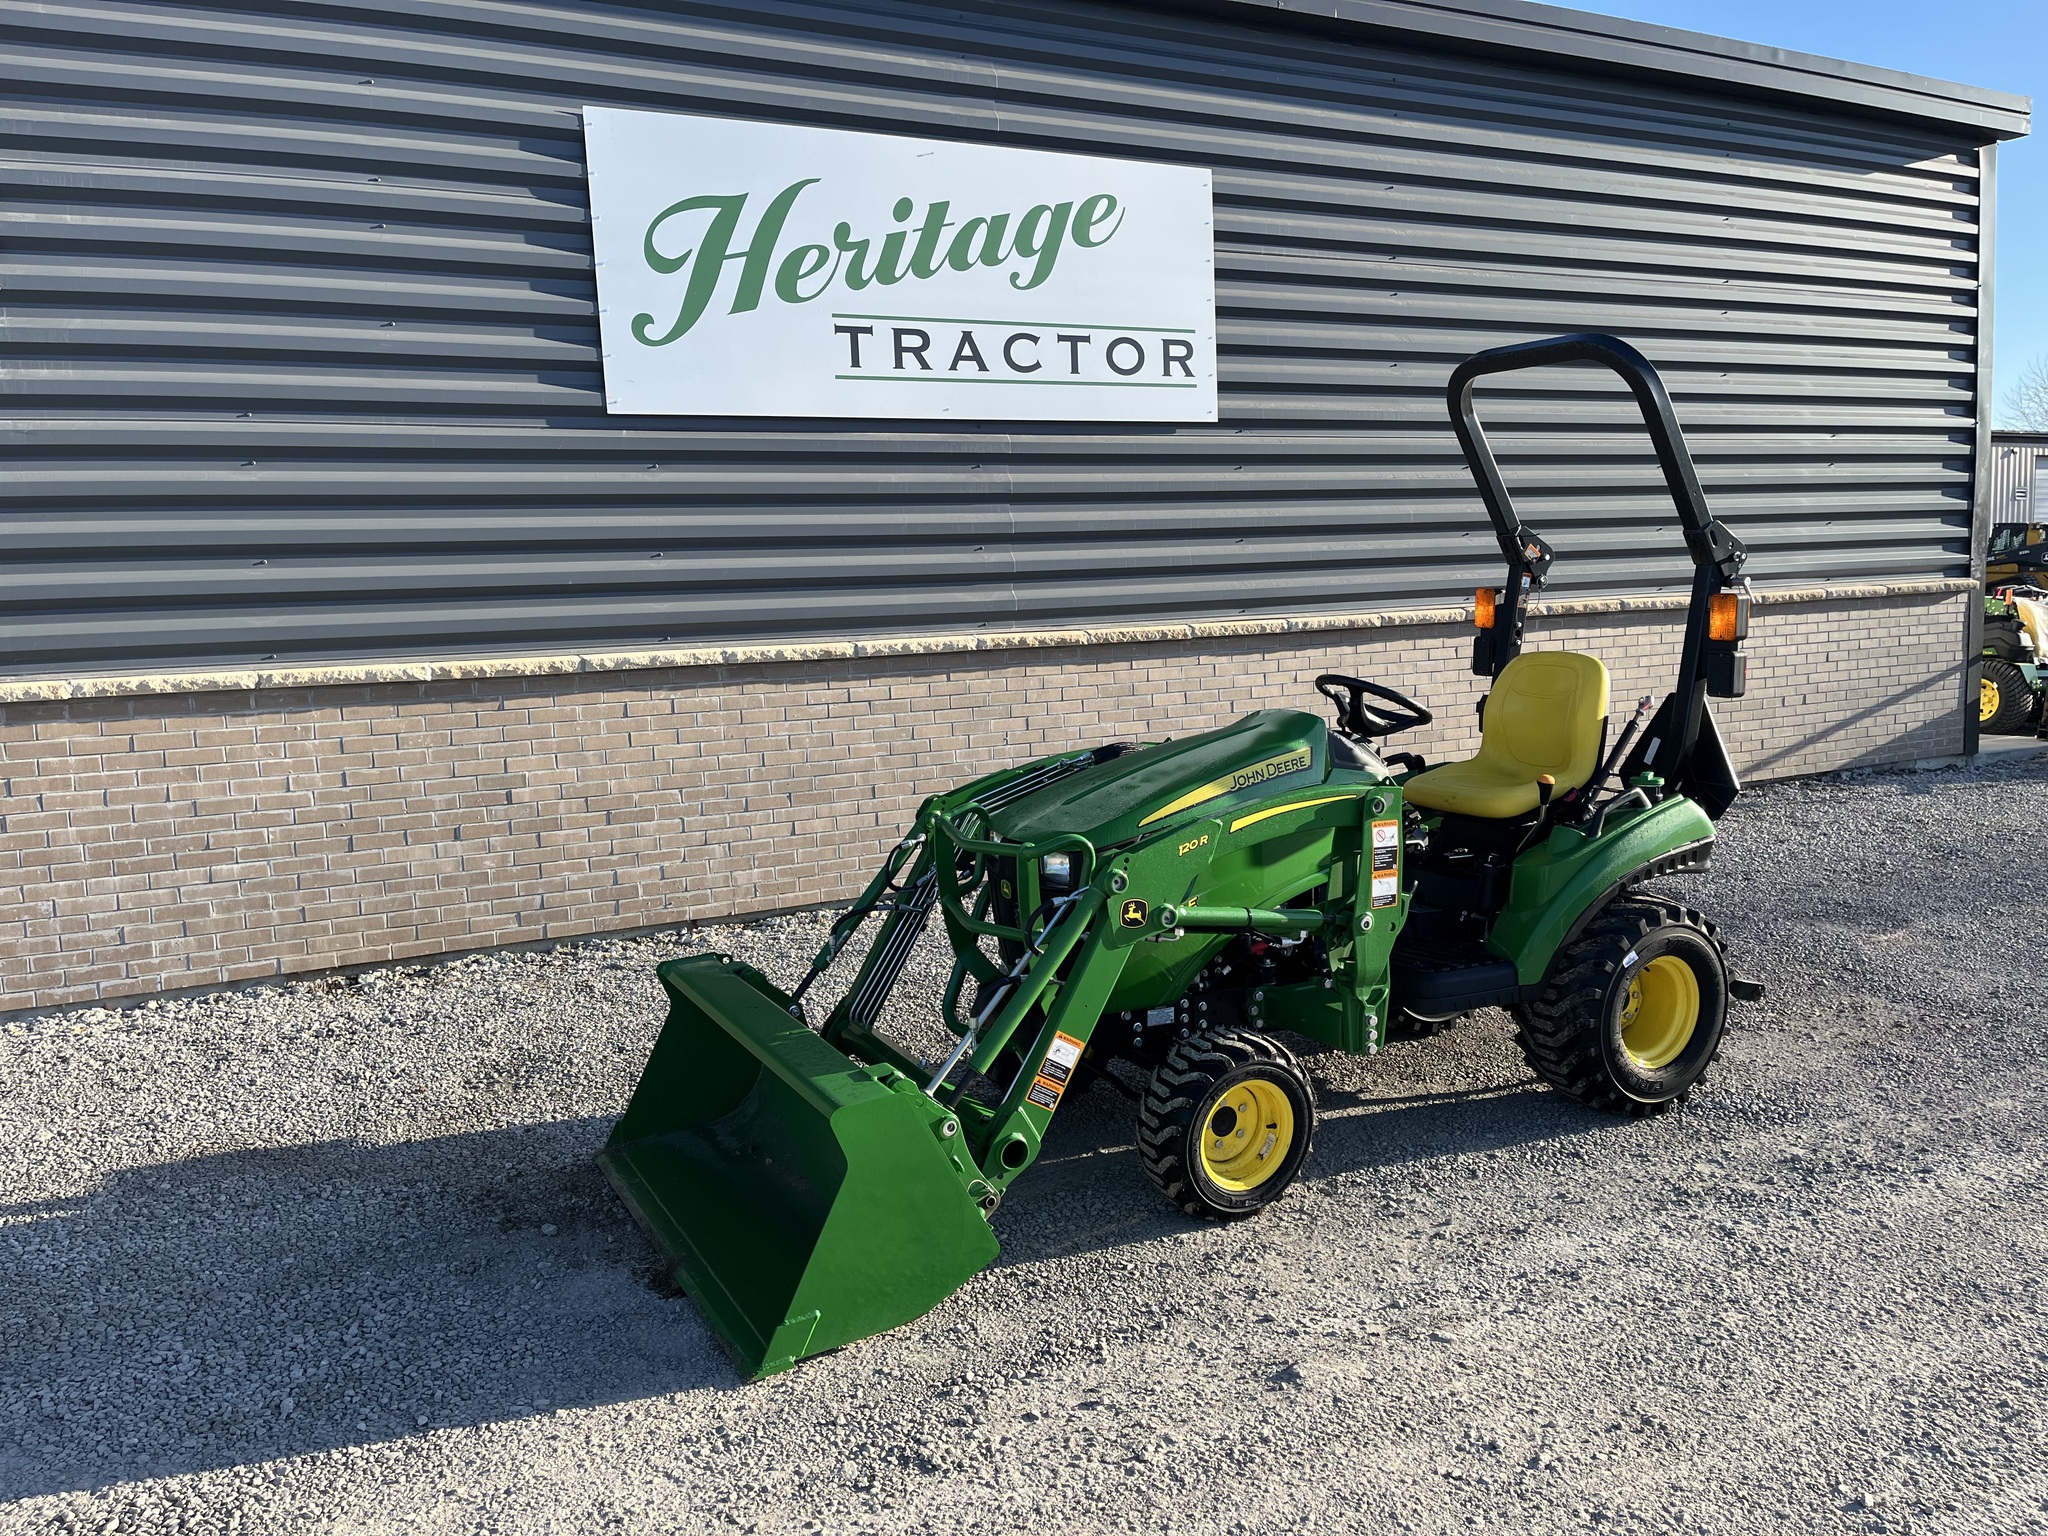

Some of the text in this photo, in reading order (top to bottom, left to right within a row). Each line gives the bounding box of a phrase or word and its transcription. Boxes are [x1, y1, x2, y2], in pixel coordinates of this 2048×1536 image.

[631, 177, 1125, 348] Heritage
[834, 323, 1196, 378] TRACTOR
[1230, 756, 1306, 790] JOHN DEERE
